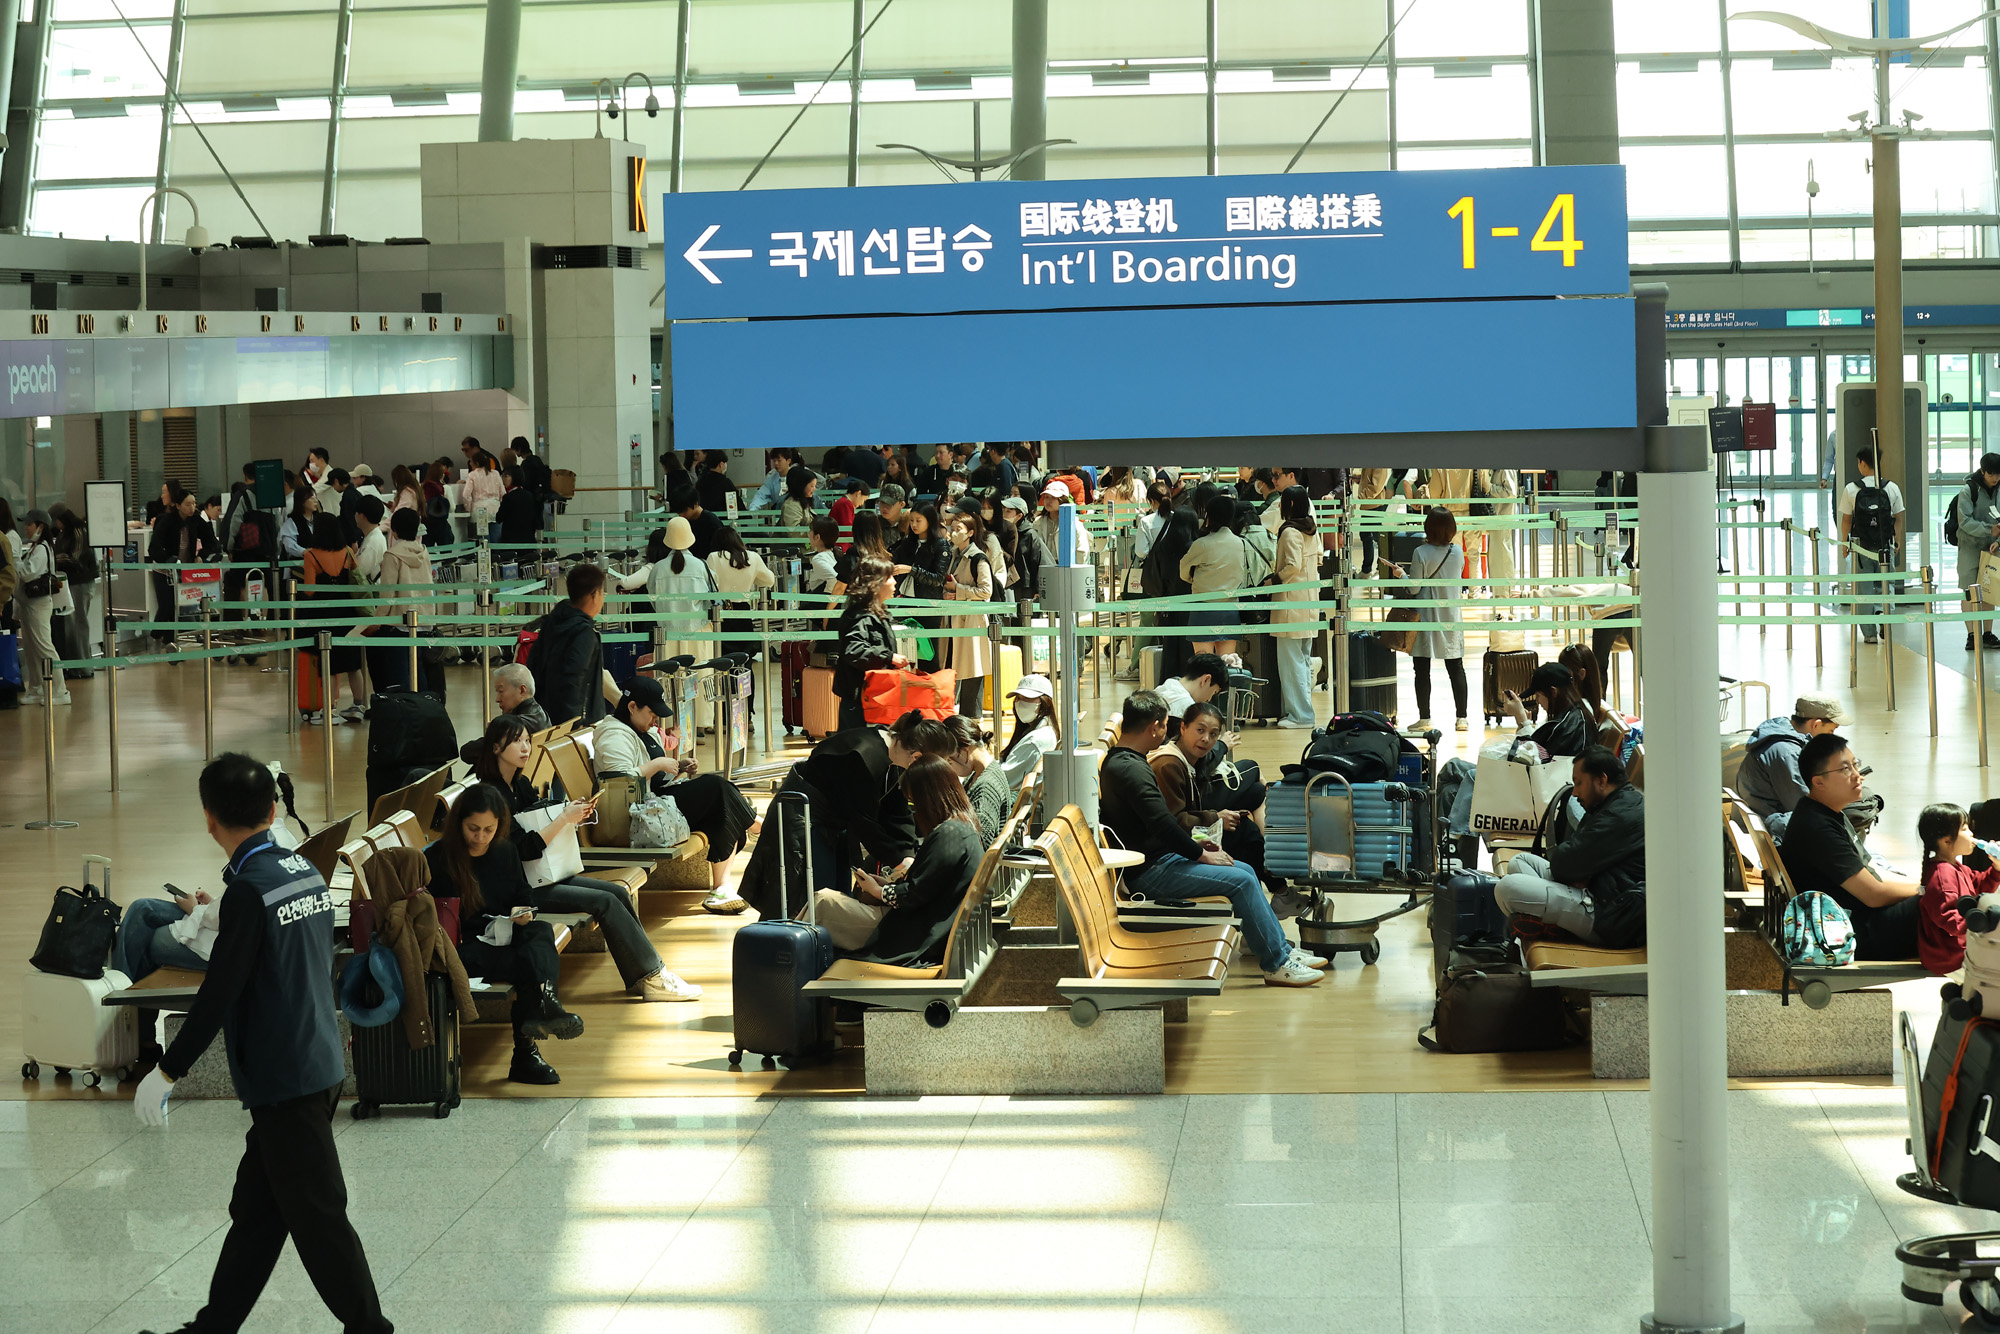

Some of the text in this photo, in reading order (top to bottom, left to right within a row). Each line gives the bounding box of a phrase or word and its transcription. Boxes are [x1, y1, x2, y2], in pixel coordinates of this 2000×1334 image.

[628, 156, 648, 232] K
[1019, 193, 1383, 237] 国际线登机 国際線搭乗
[769, 223, 993, 278] 국제선탑승
[1022, 245, 1297, 289] Int'l Boarding
[32, 314, 49, 335] K11
[77, 314, 95, 334] K10
[157, 314, 168, 333] K9
[196, 314, 207, 333] K8
[1697, 321, 1723, 329] Departures
[1714, 312, 1735, 322] 입니다
[1916, 312, 1924, 320] 12
[7, 354, 57, 405] peach
[1473, 813, 1538, 831] GENERAL
